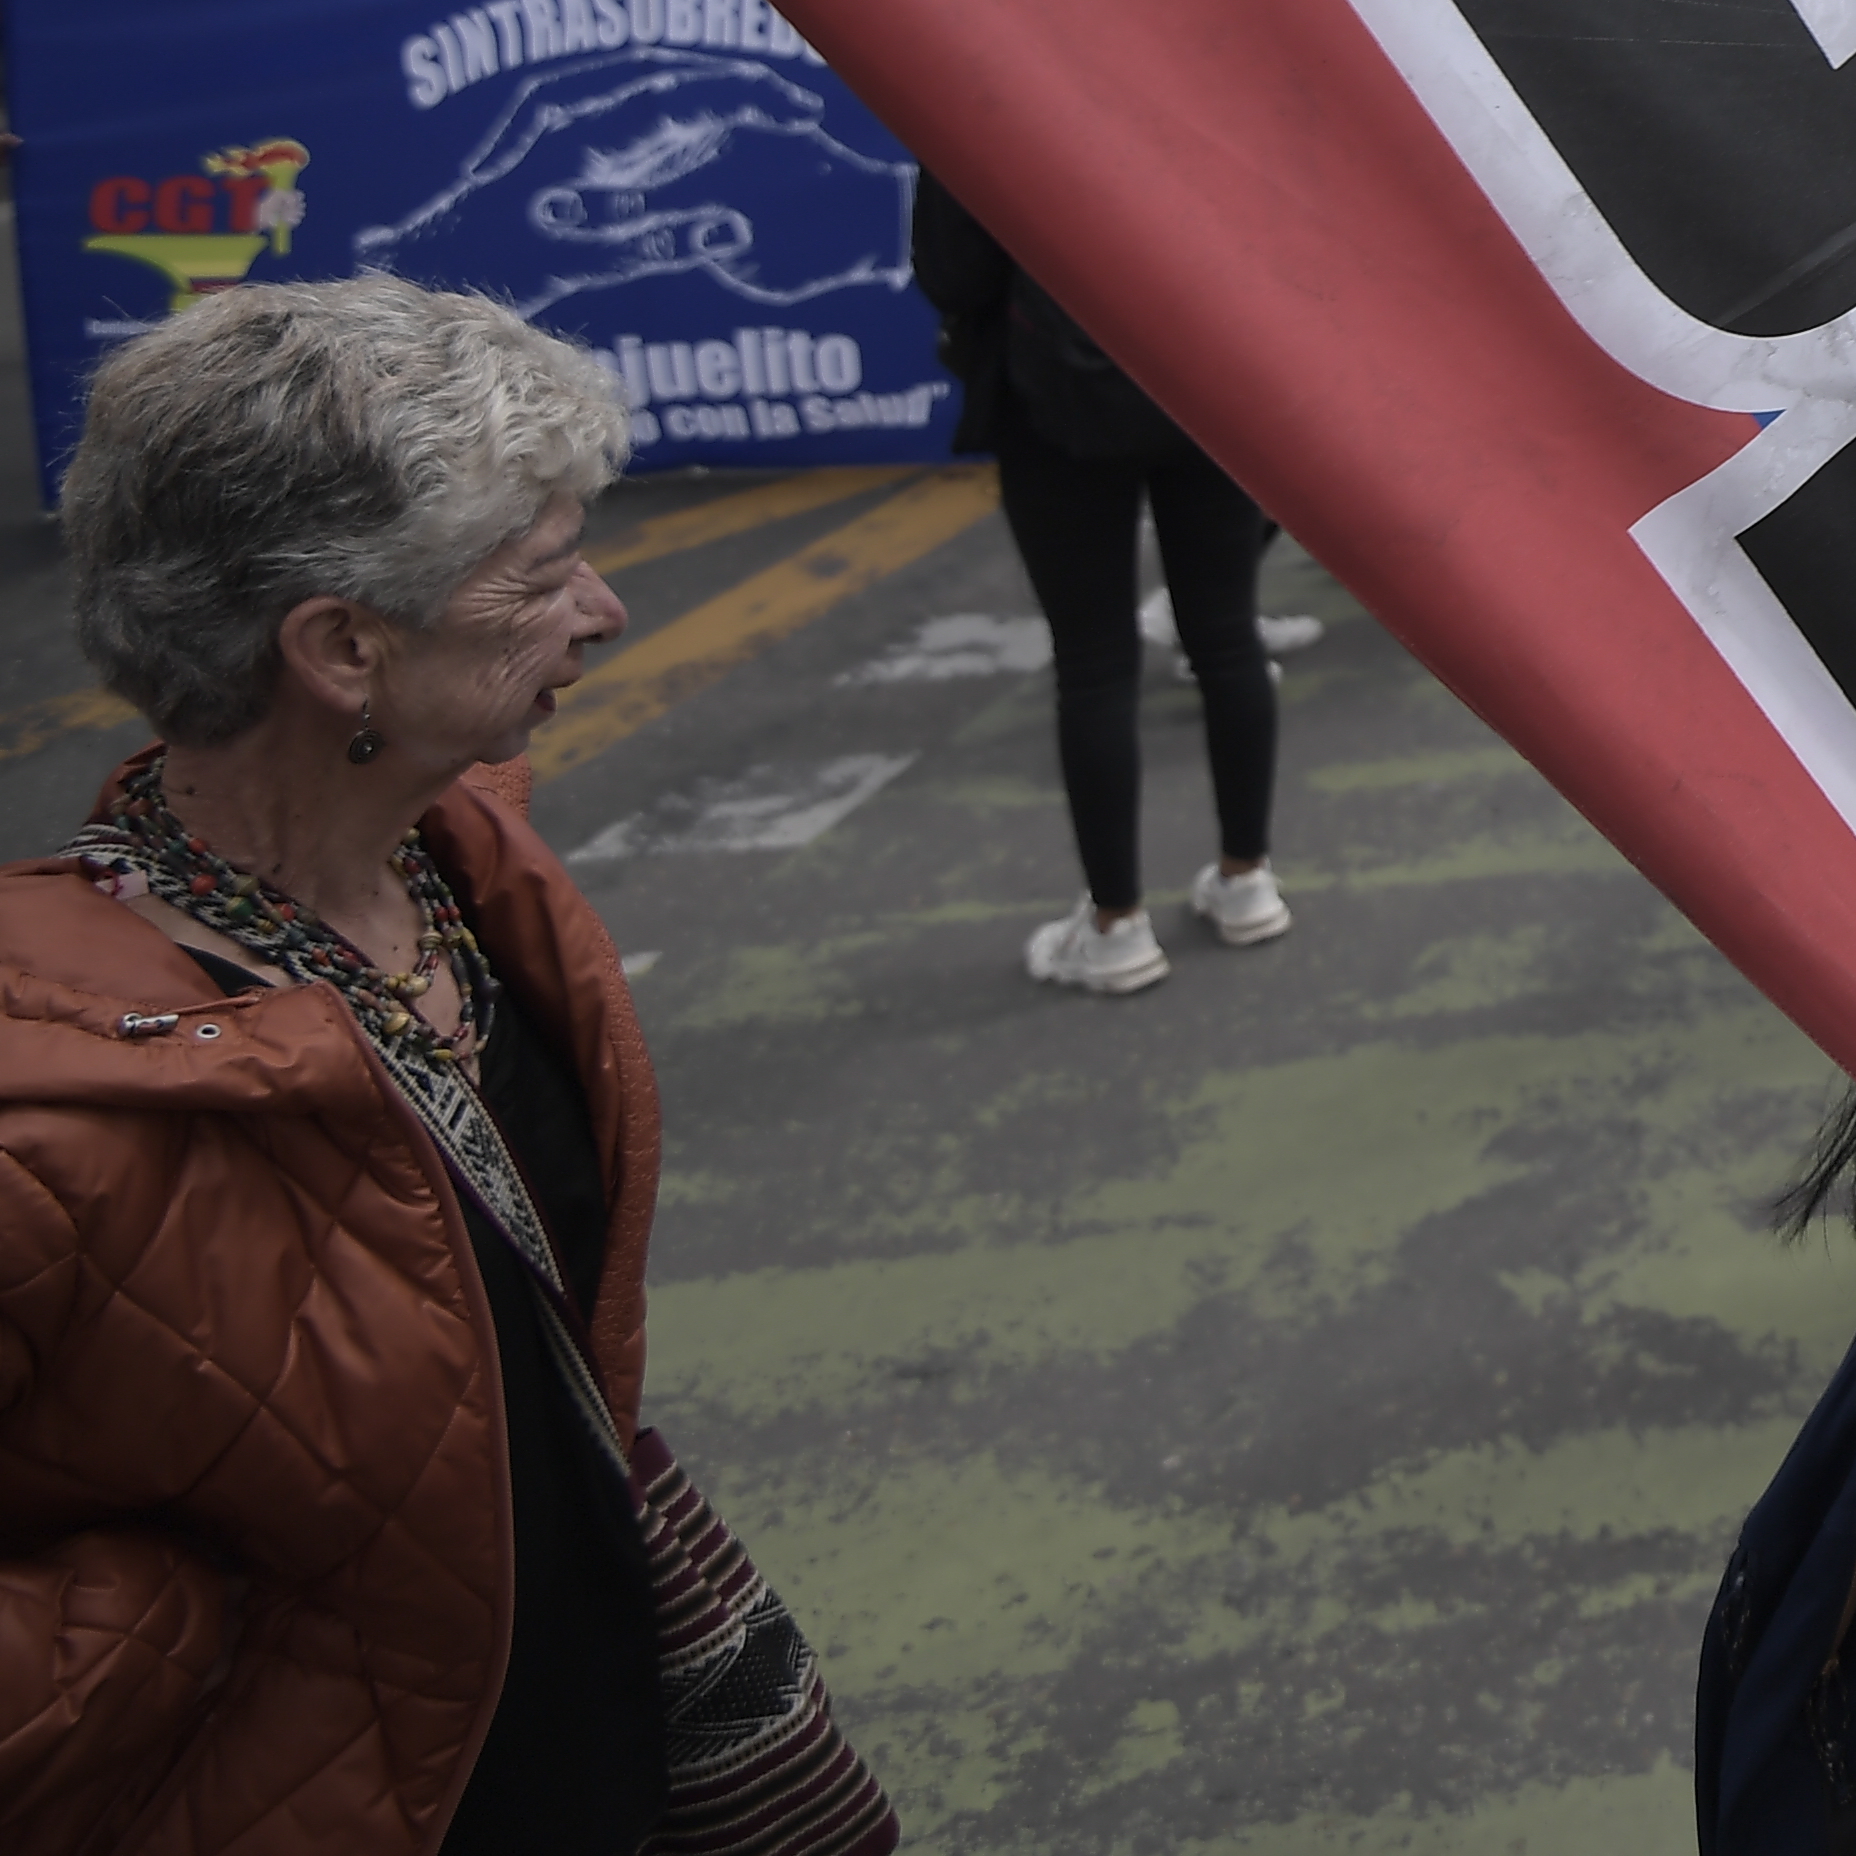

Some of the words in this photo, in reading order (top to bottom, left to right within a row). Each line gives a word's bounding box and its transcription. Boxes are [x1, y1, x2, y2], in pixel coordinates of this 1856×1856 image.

[88, 174, 272, 235] CGT
[666, 403, 750, 440] con
[752, 397, 801, 439] la
